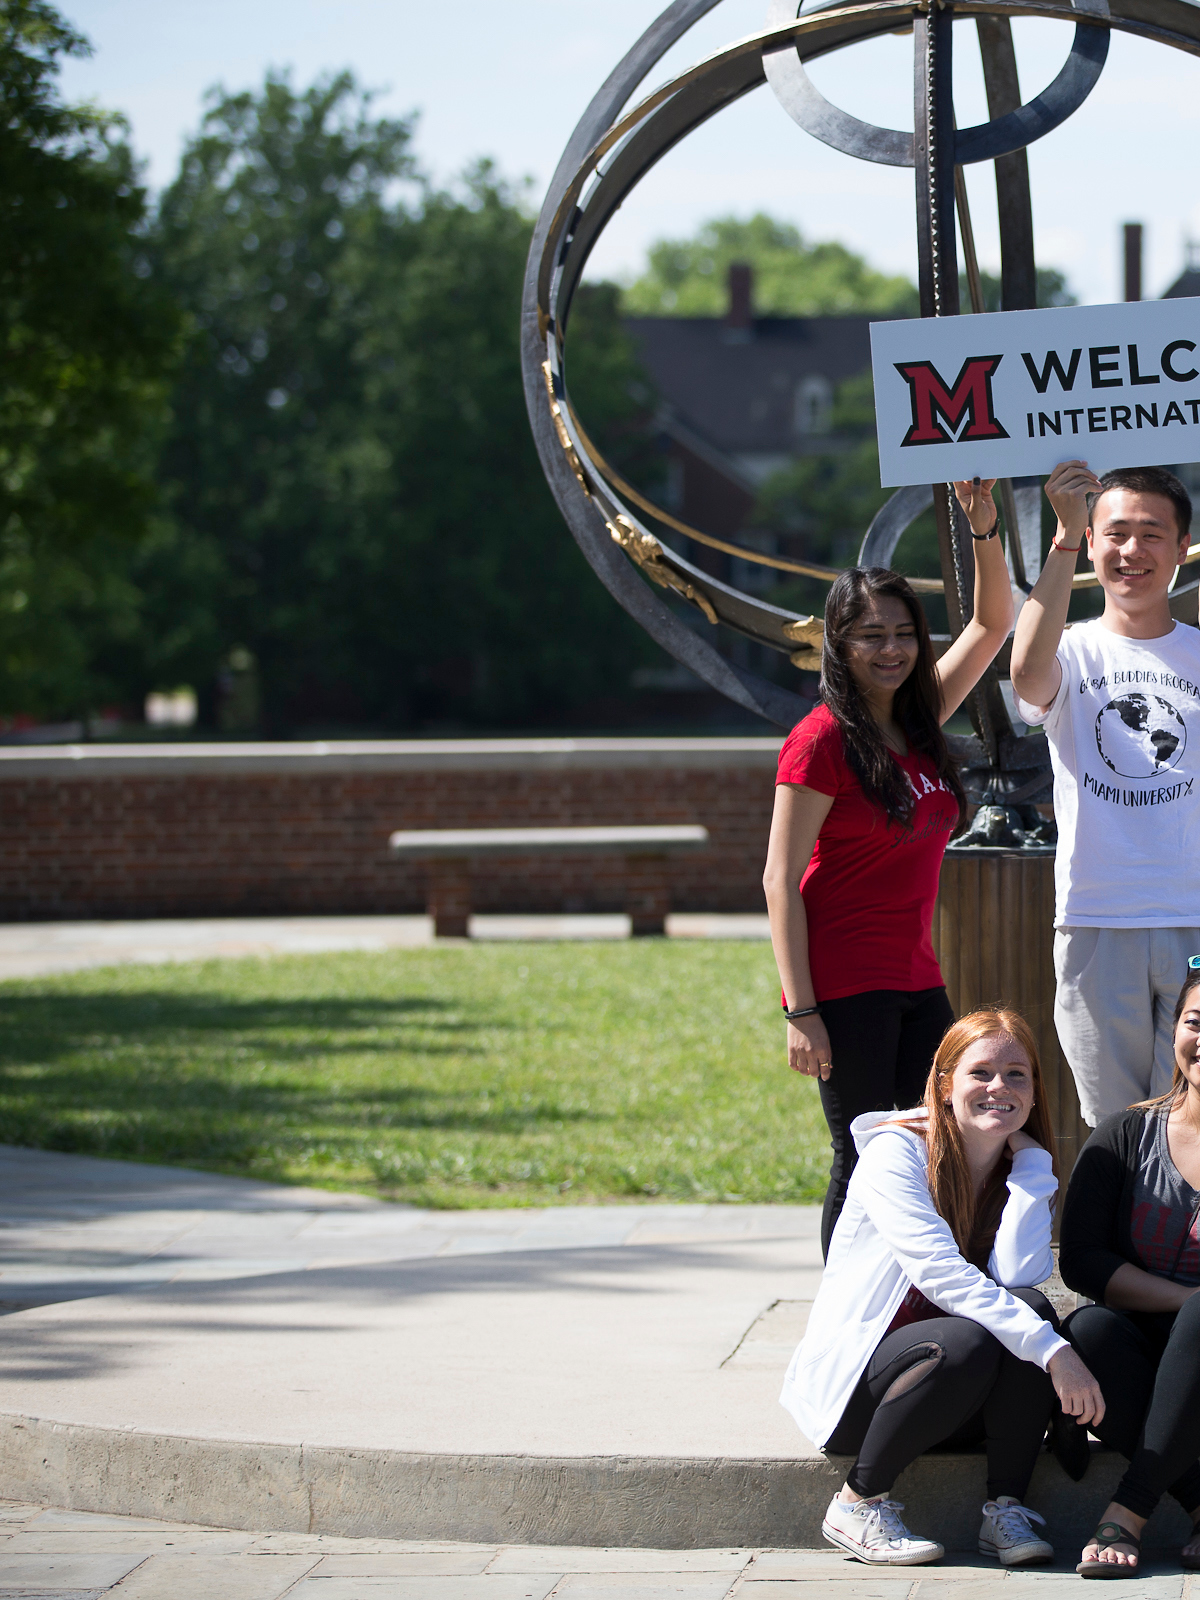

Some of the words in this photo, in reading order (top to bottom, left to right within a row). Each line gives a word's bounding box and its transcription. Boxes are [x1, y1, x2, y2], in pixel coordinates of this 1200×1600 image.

[894, 354, 1011, 447] M
[1080, 675, 1110, 694] GLBAL
[1114, 670, 1158, 684] BUDDIES
[1084, 772, 1119, 805] MIAMI
